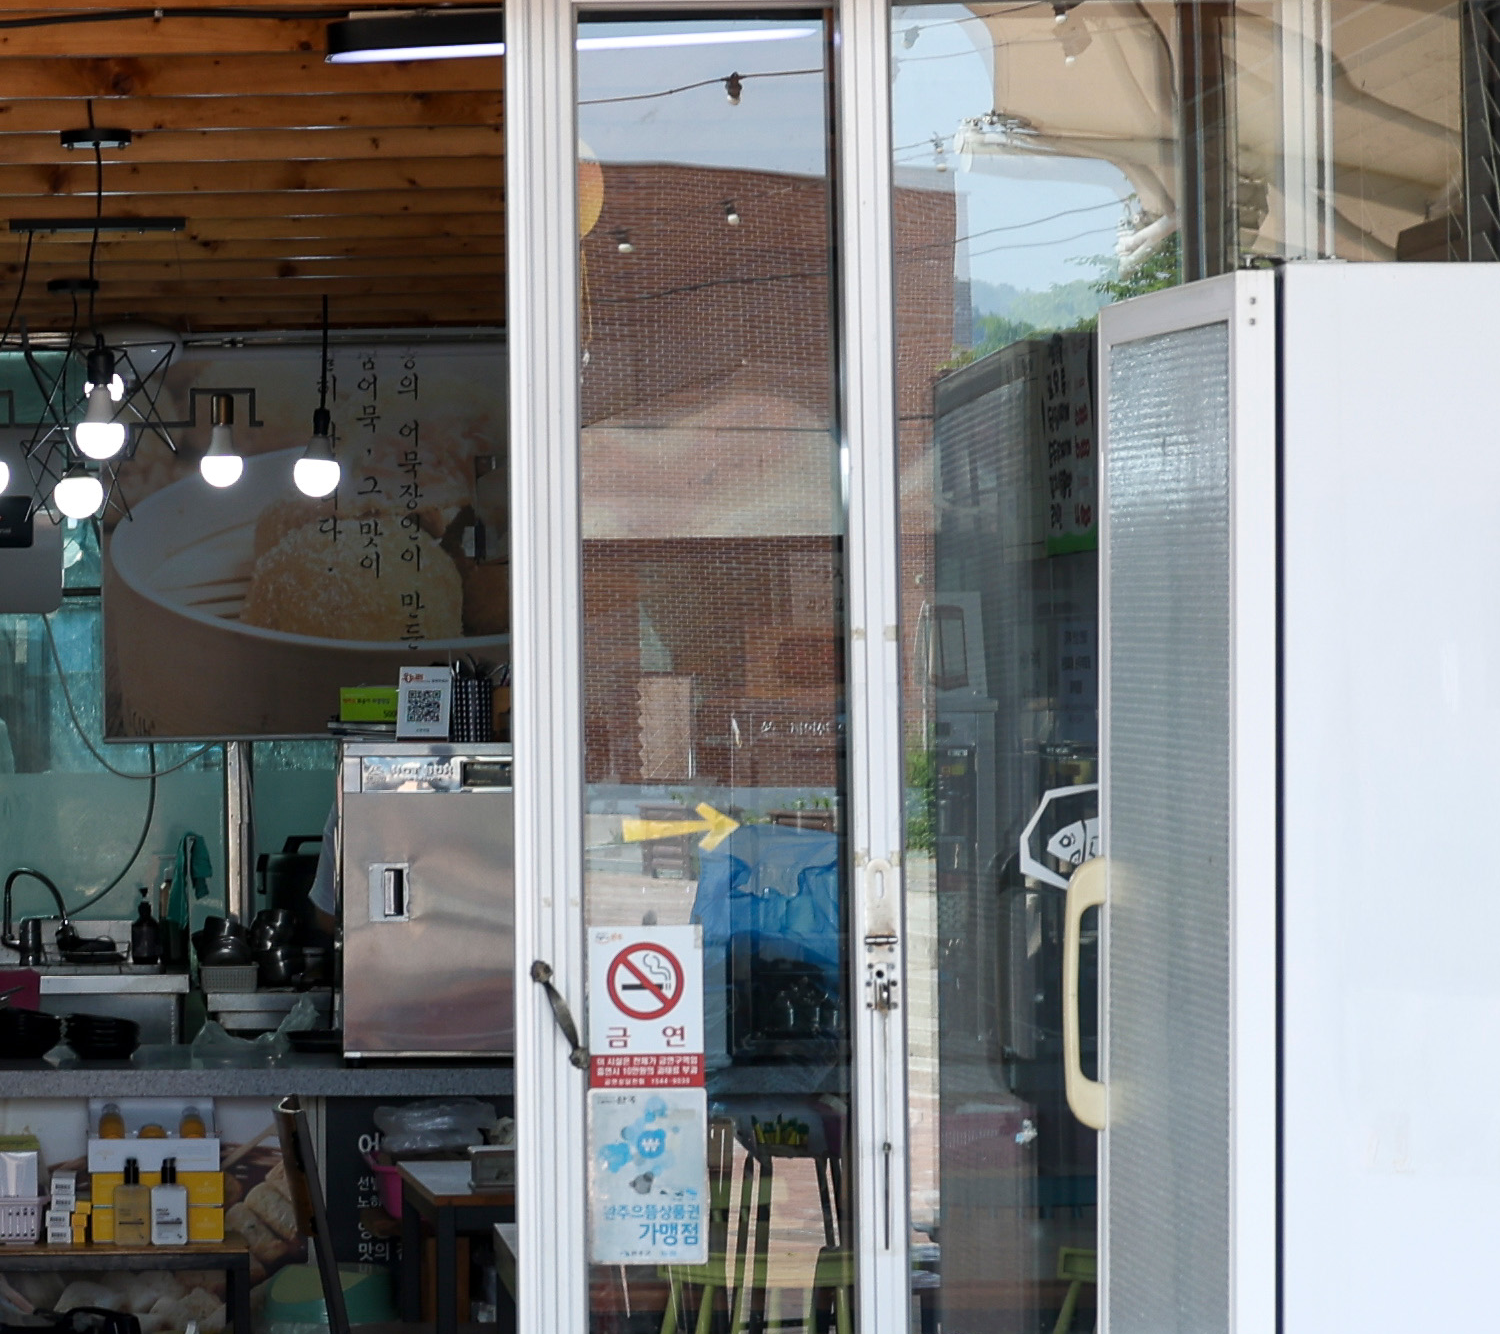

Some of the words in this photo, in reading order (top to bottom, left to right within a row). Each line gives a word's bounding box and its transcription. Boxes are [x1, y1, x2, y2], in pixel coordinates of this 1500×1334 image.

[359, 520, 382, 579] 맛이
[400, 591, 426, 650] 만든
[639, 1222, 698, 1246] 가맹점
